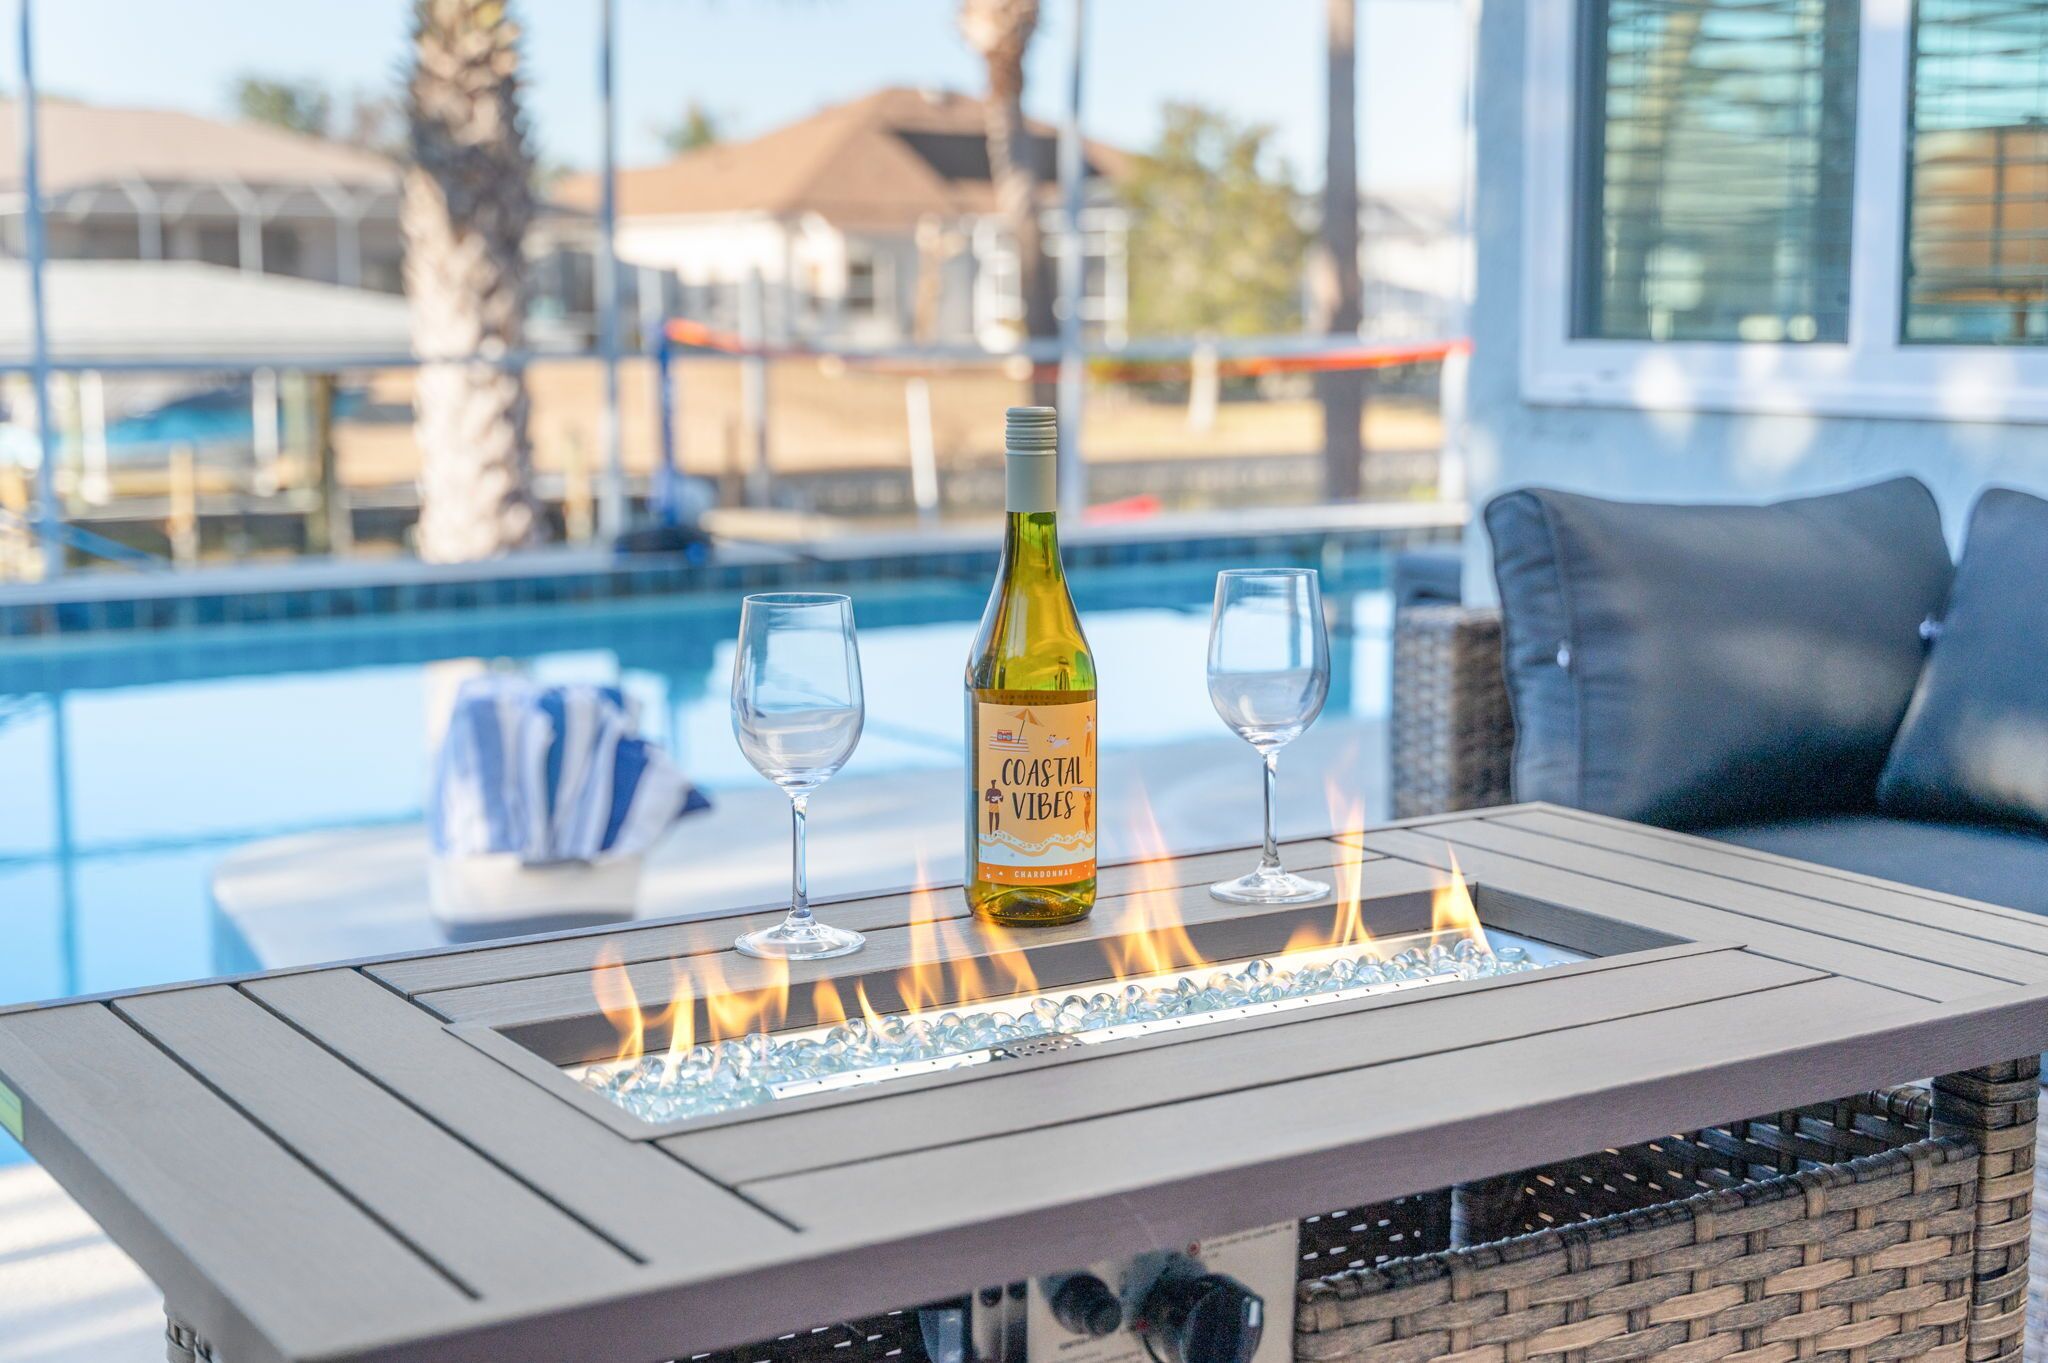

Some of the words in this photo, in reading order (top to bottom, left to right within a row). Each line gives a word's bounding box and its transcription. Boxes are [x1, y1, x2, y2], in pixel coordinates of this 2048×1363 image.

[1002, 756, 1083, 787] COASTAL
[1012, 790, 1076, 820] VIBES
[1014, 868, 1073, 878] CHARDONNAY
